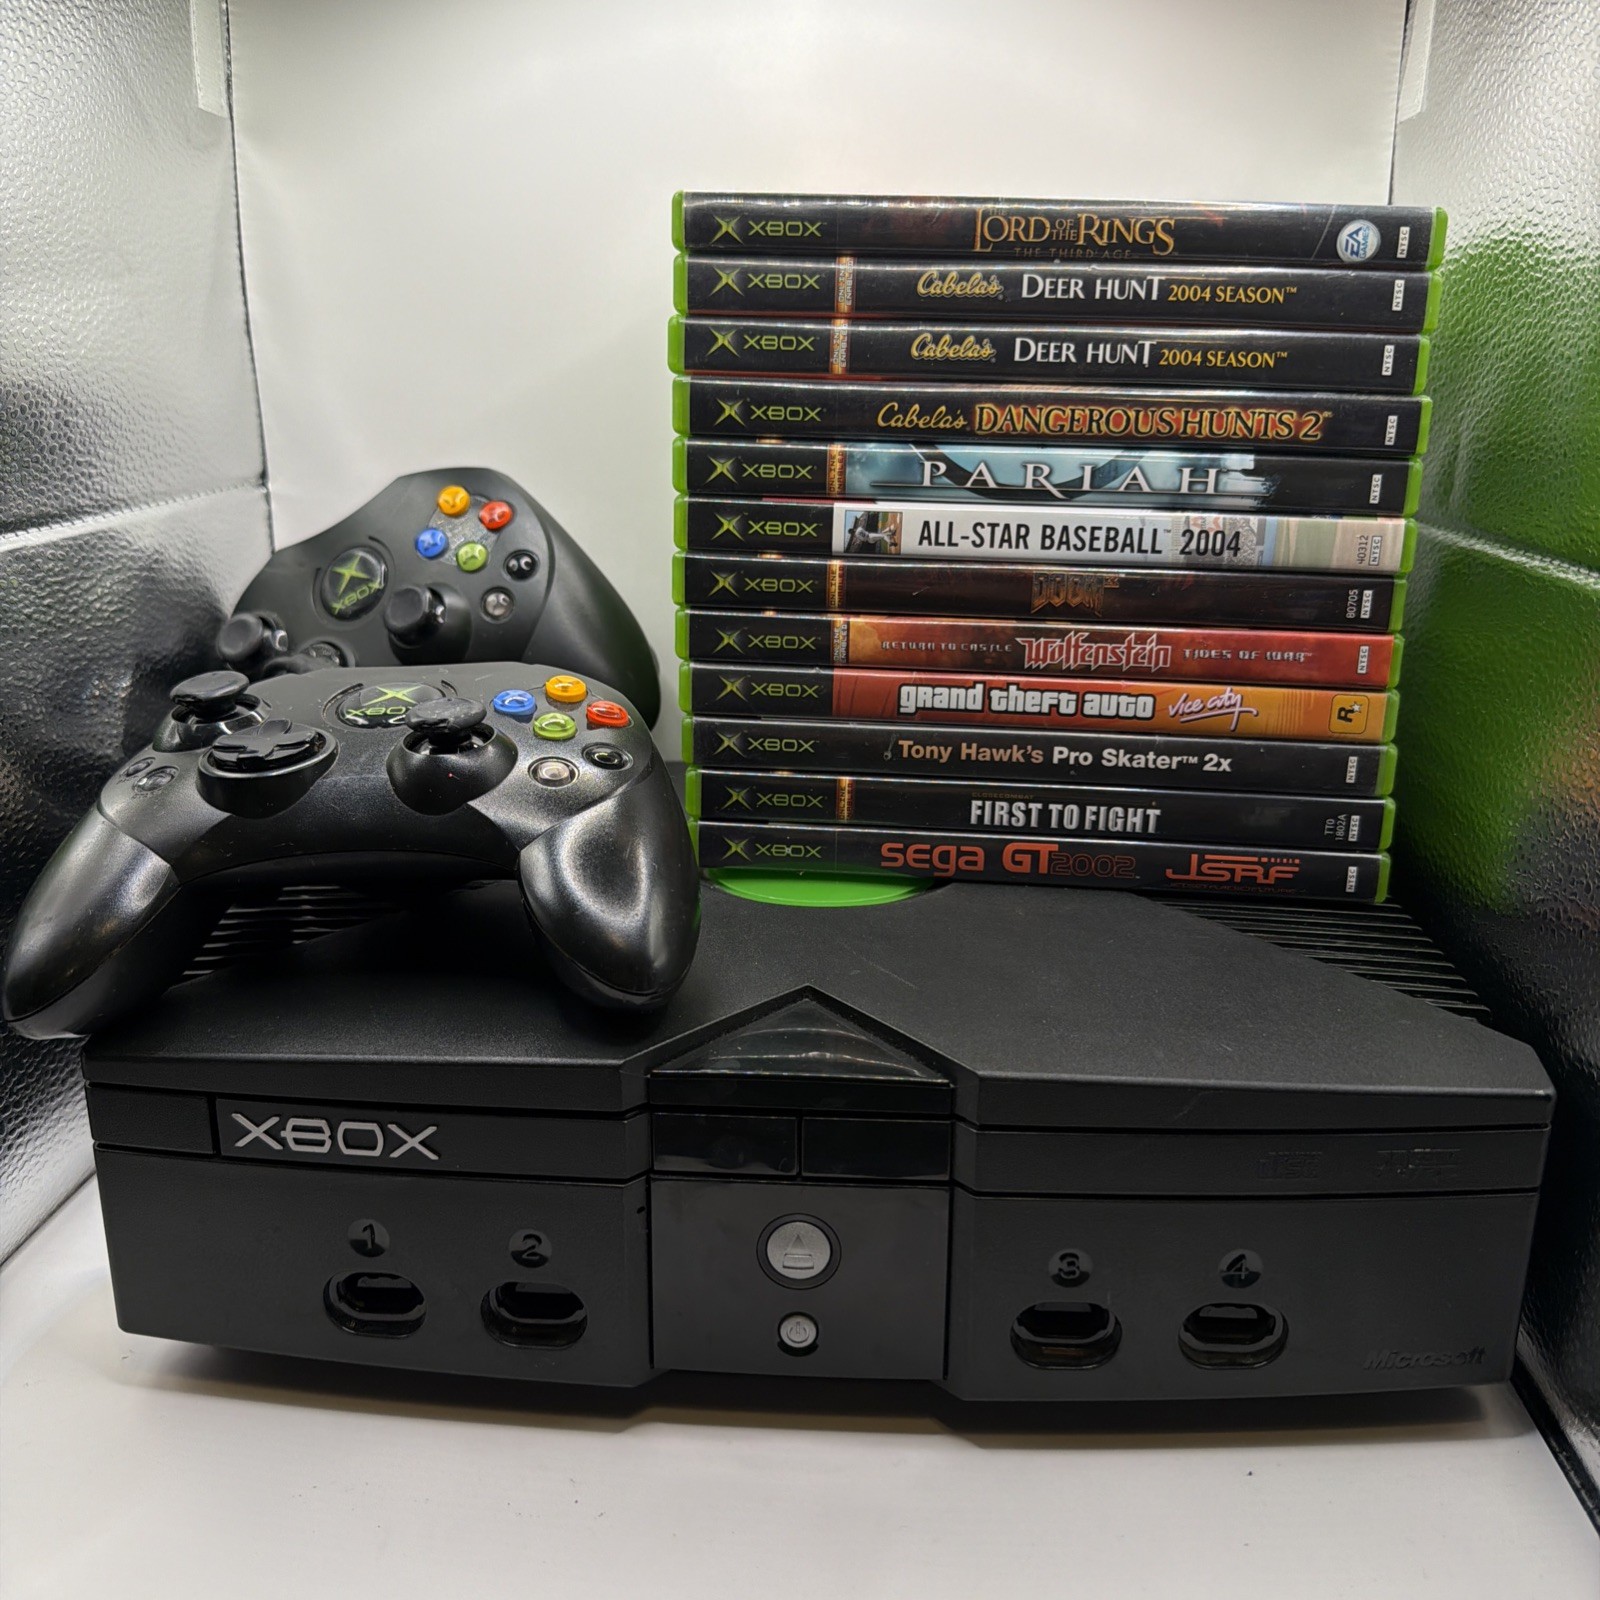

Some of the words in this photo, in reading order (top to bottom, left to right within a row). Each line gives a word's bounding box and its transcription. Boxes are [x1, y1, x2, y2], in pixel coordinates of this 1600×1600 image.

[748, 220, 822, 238] XBOX
[974, 208, 1050, 252] LORD
[1051, 229, 1077, 241] THE
[1055, 219, 1074, 230] OF
[1075, 213, 1175, 256] RINGS
[1014, 247, 1039, 257] THE
[1049, 248, 1096, 258] THIRD
[1101, 249, 1132, 259] AGE
[1398, 229, 1408, 256] NTSC
[747, 273, 821, 290] XBOX
[917, 270, 1003, 298] Cabela's
[1021, 274, 1085, 299] DEER
[1095, 276, 1166, 301] HUNT
[1168, 285, 1212, 302] 2004
[1394, 281, 1404, 309] NTSC
[743, 335, 816, 352] XBOX
[911, 333, 996, 361] Cabela's
[1013, 338, 1076, 363] DEER
[1086, 341, 1156, 367] HUNT
[1159, 349, 1202, 367] 2004
[1383, 345, 1393, 375] NTSC
[750, 405, 822, 422] XBOX
[877, 402, 967, 429] Cabela's
[974, 402, 1176, 438] DANGEROUS
[1180, 408, 1295, 440] HUNTS
[1299, 410, 1323, 442] 2
[1386, 416, 1396, 445] NTSC
[742, 464, 813, 479] XBOX
[920, 460, 1226, 499] PARIAH
[1370, 475, 1380, 502] NTSC
[748, 521, 818, 537] XBOX
[918, 520, 1030, 550] ALL-STAR
[1179, 529, 1241, 557] 2004
[1358, 535, 1369, 564] 40312
[1371, 537, 1381, 565] NTSC
[332, 580, 383, 615] XBOX
[744, 577, 814, 593] XBOX
[1345, 589, 1359, 619] 80705
[1361, 592, 1372, 618] NTSC
[748, 635, 816, 650] XBOX
[882, 641, 935, 650] RETURN
[941, 642, 956, 651] TO
[1015, 630, 1172, 673] Wolfenstein
[1238, 650, 1260, 660] OF
[1358, 647, 1368, 672] NTSC
[750, 683, 820, 699] XBOX
[990, 685, 1077, 714] theft
[1082, 690, 1156, 719] auto
[347, 706, 414, 716] XBO
[748, 738, 816, 753] XBOX
[898, 740, 953, 763] Tony
[961, 742, 1044, 763] Hawk's
[1052, 746, 1093, 767] Pro
[1202, 753, 1232, 772] 2x
[1347, 758, 1356, 782] NTSC
[756, 792, 824, 808] XBOX
[970, 799, 1042, 828] FIRST
[1048, 803, 1080, 830] TO
[1084, 805, 1162, 834] FIGHT
[1350, 817, 1359, 840] NTSC
[755, 843, 822, 859] XBOX
[1002, 842, 1059, 874] GT
[1050, 852, 1137, 879] 2002
[1165, 853, 1300, 884] JSRF
[1347, 868, 1356, 891] NTSC
[231, 1112, 440, 1160] XBOX
[361, 1222, 377, 1250] 1
[521, 1233, 544, 1261] 2
[1057, 1252, 1082, 1280] 3
[1221, 1253, 1250, 1280] 4
[1363, 1345, 1487, 1372] Microsoft
